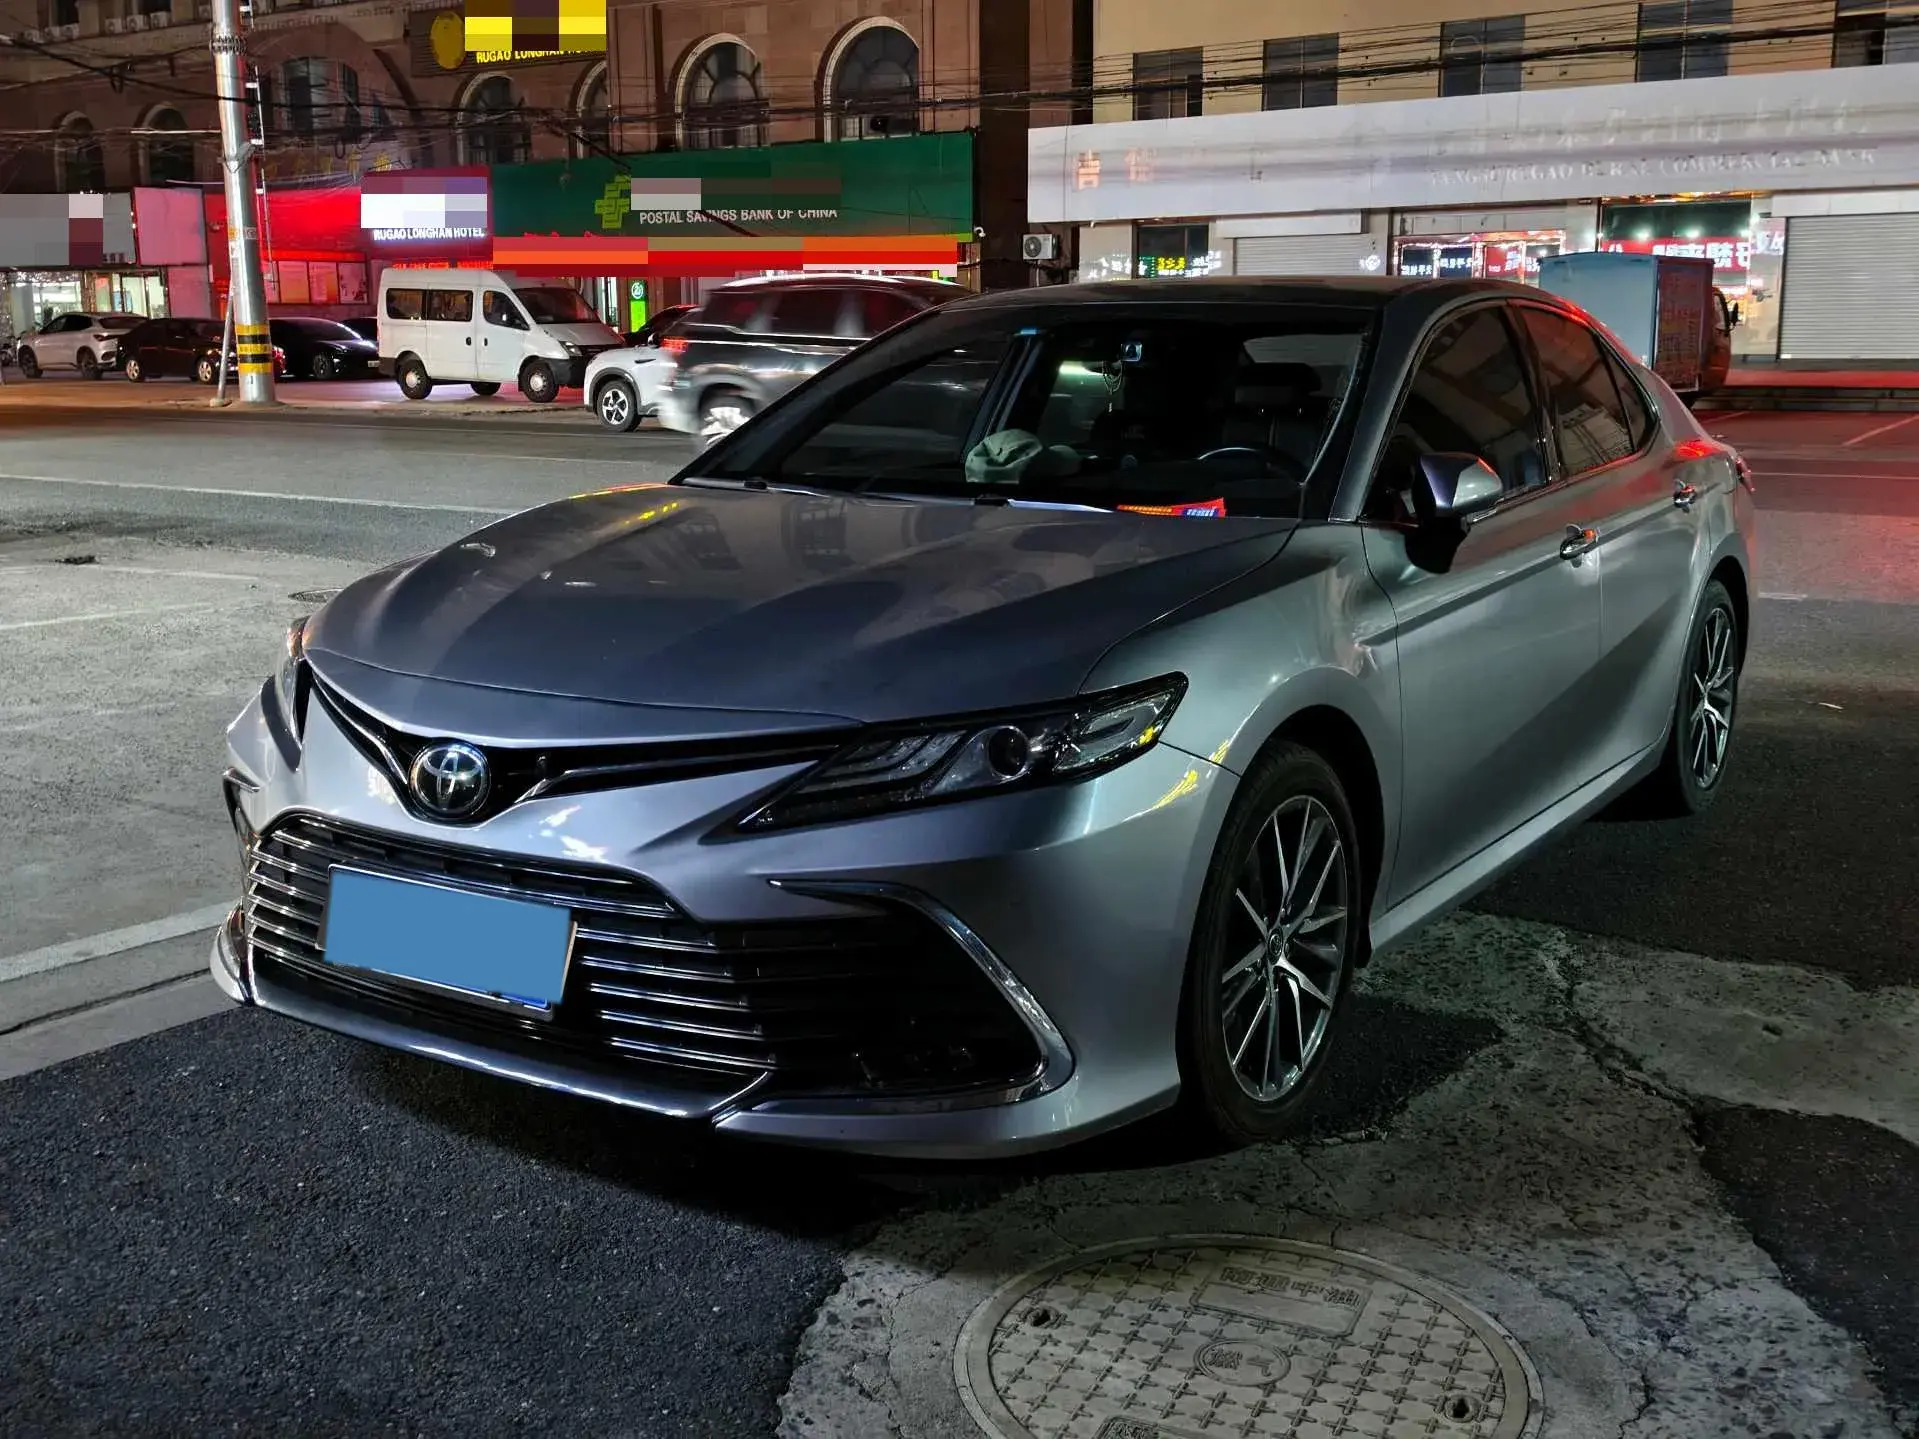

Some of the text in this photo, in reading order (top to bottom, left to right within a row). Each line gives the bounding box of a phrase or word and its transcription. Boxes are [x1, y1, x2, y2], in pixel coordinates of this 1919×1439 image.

[476, 50, 512, 63] RUGAO
[639, 210, 684, 225] POSTAL
[740, 209, 774, 221] BANK
[777, 209, 794, 219] OF
[799, 209, 838, 219] CHINA
[373, 227, 485, 241] RUGAO LONGHAN HOTEL
